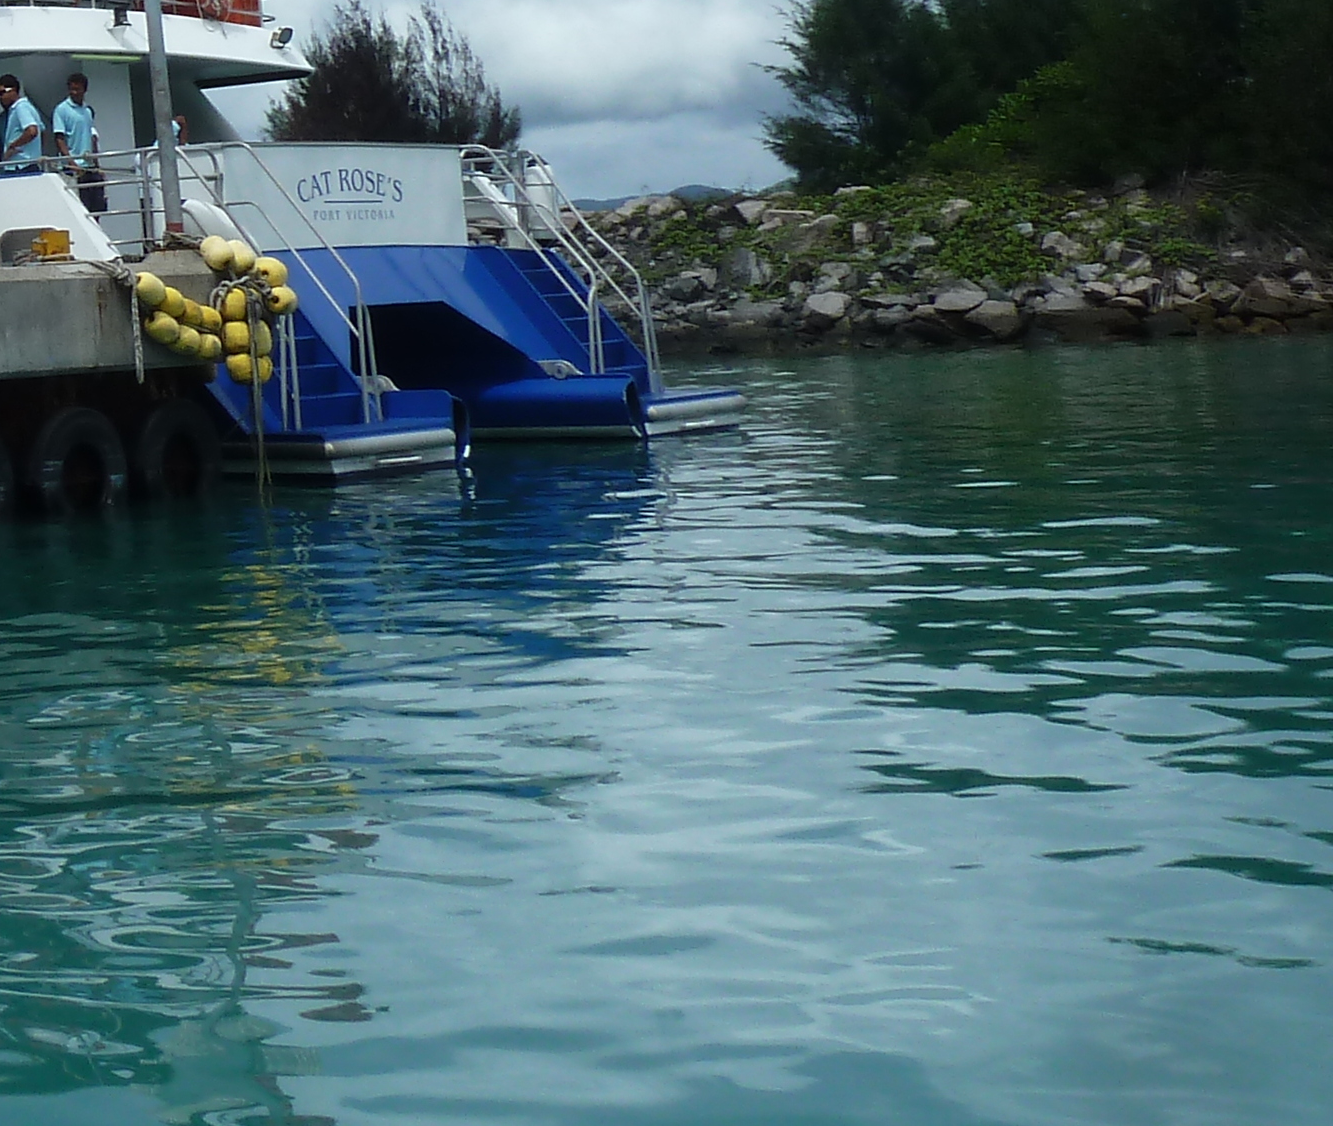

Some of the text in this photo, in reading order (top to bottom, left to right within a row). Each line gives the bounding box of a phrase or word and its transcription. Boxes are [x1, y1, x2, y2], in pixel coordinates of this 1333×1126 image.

[296, 168, 403, 202] CAT ROSE'S
[314, 209, 395, 221] PORT VICTORIA
